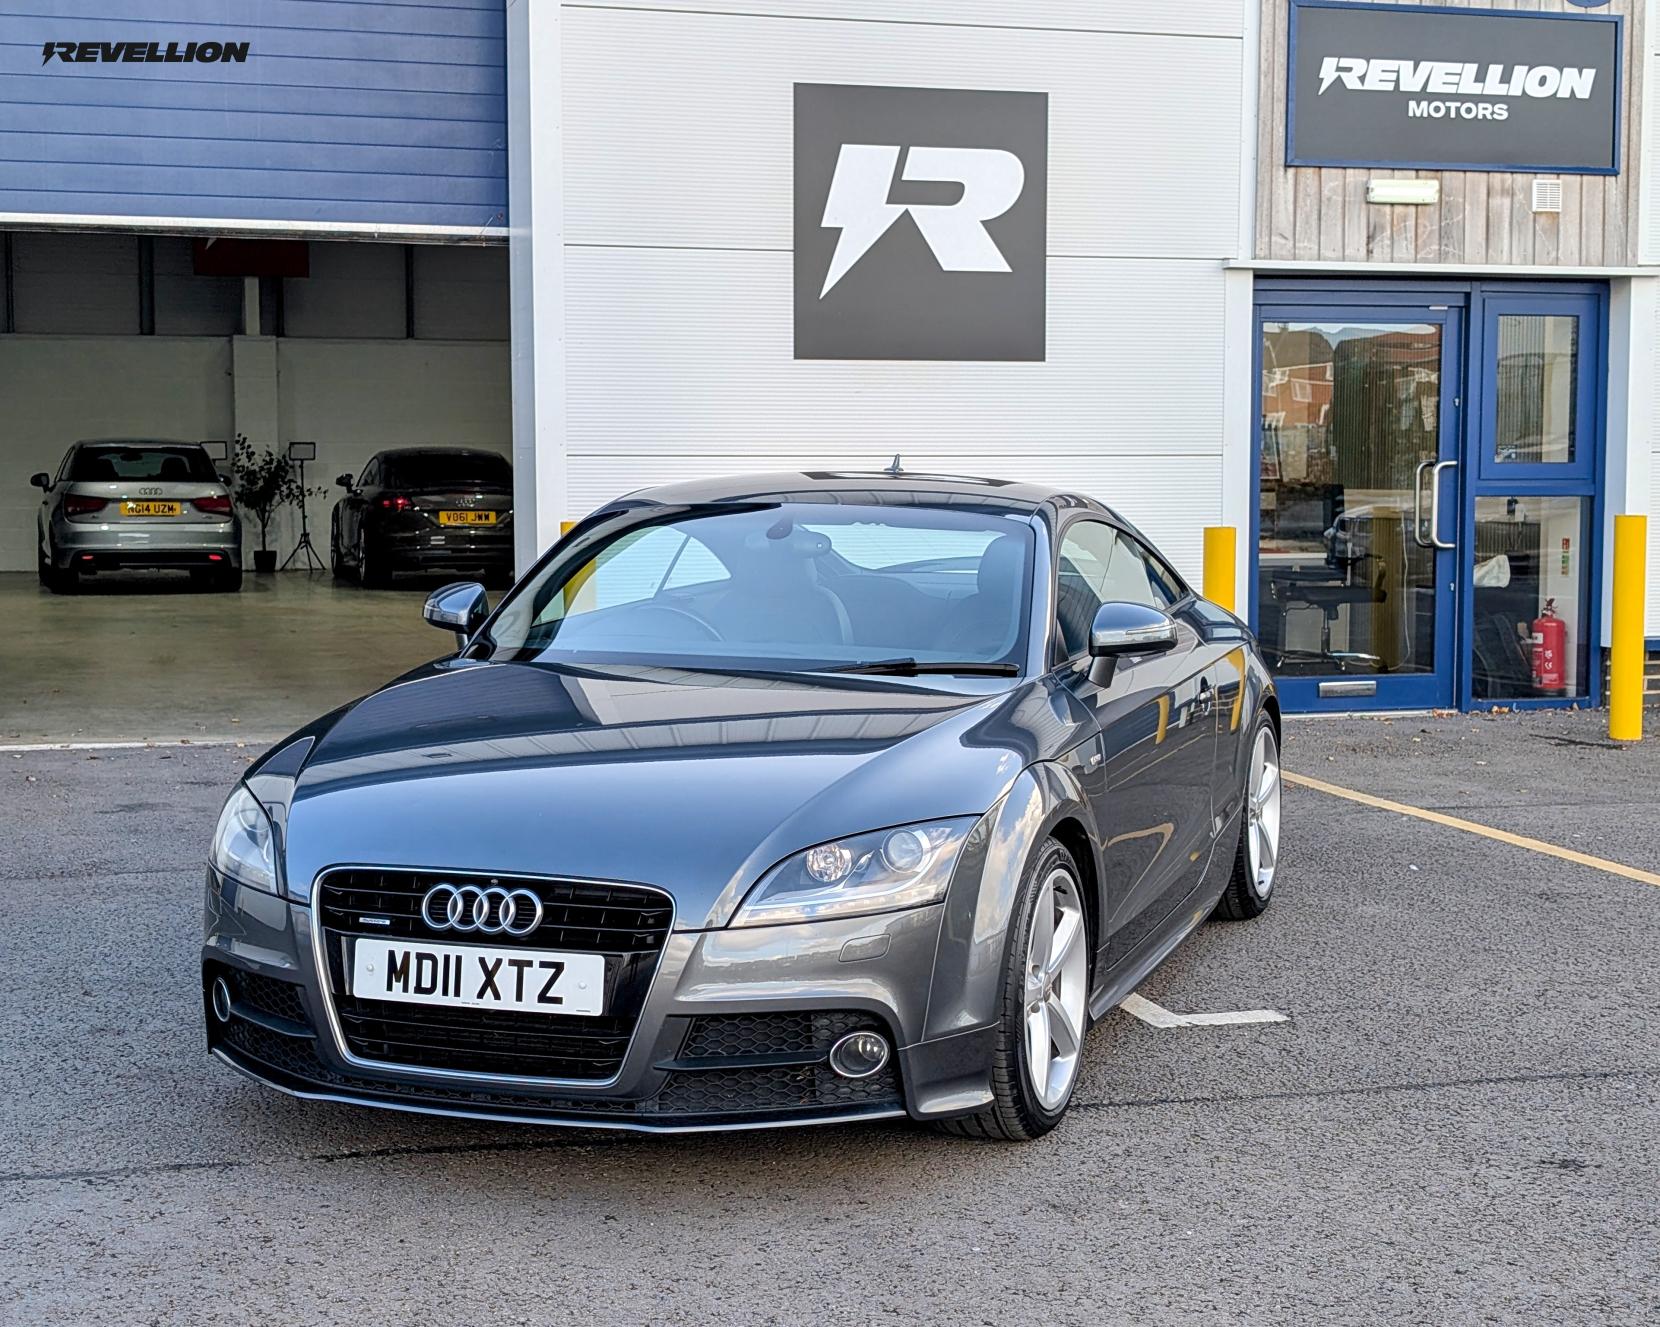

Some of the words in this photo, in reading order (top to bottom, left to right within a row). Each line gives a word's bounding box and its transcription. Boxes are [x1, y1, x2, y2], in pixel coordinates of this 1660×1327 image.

[1318, 56, 1596, 99] REVELLION
[1407, 100, 1509, 120] MOTORS
[819, 143, 1025, 299] R
[153, 503, 175, 514] UZM
[386, 949, 463, 998] MD11
[476, 956, 565, 1005] XTZ
